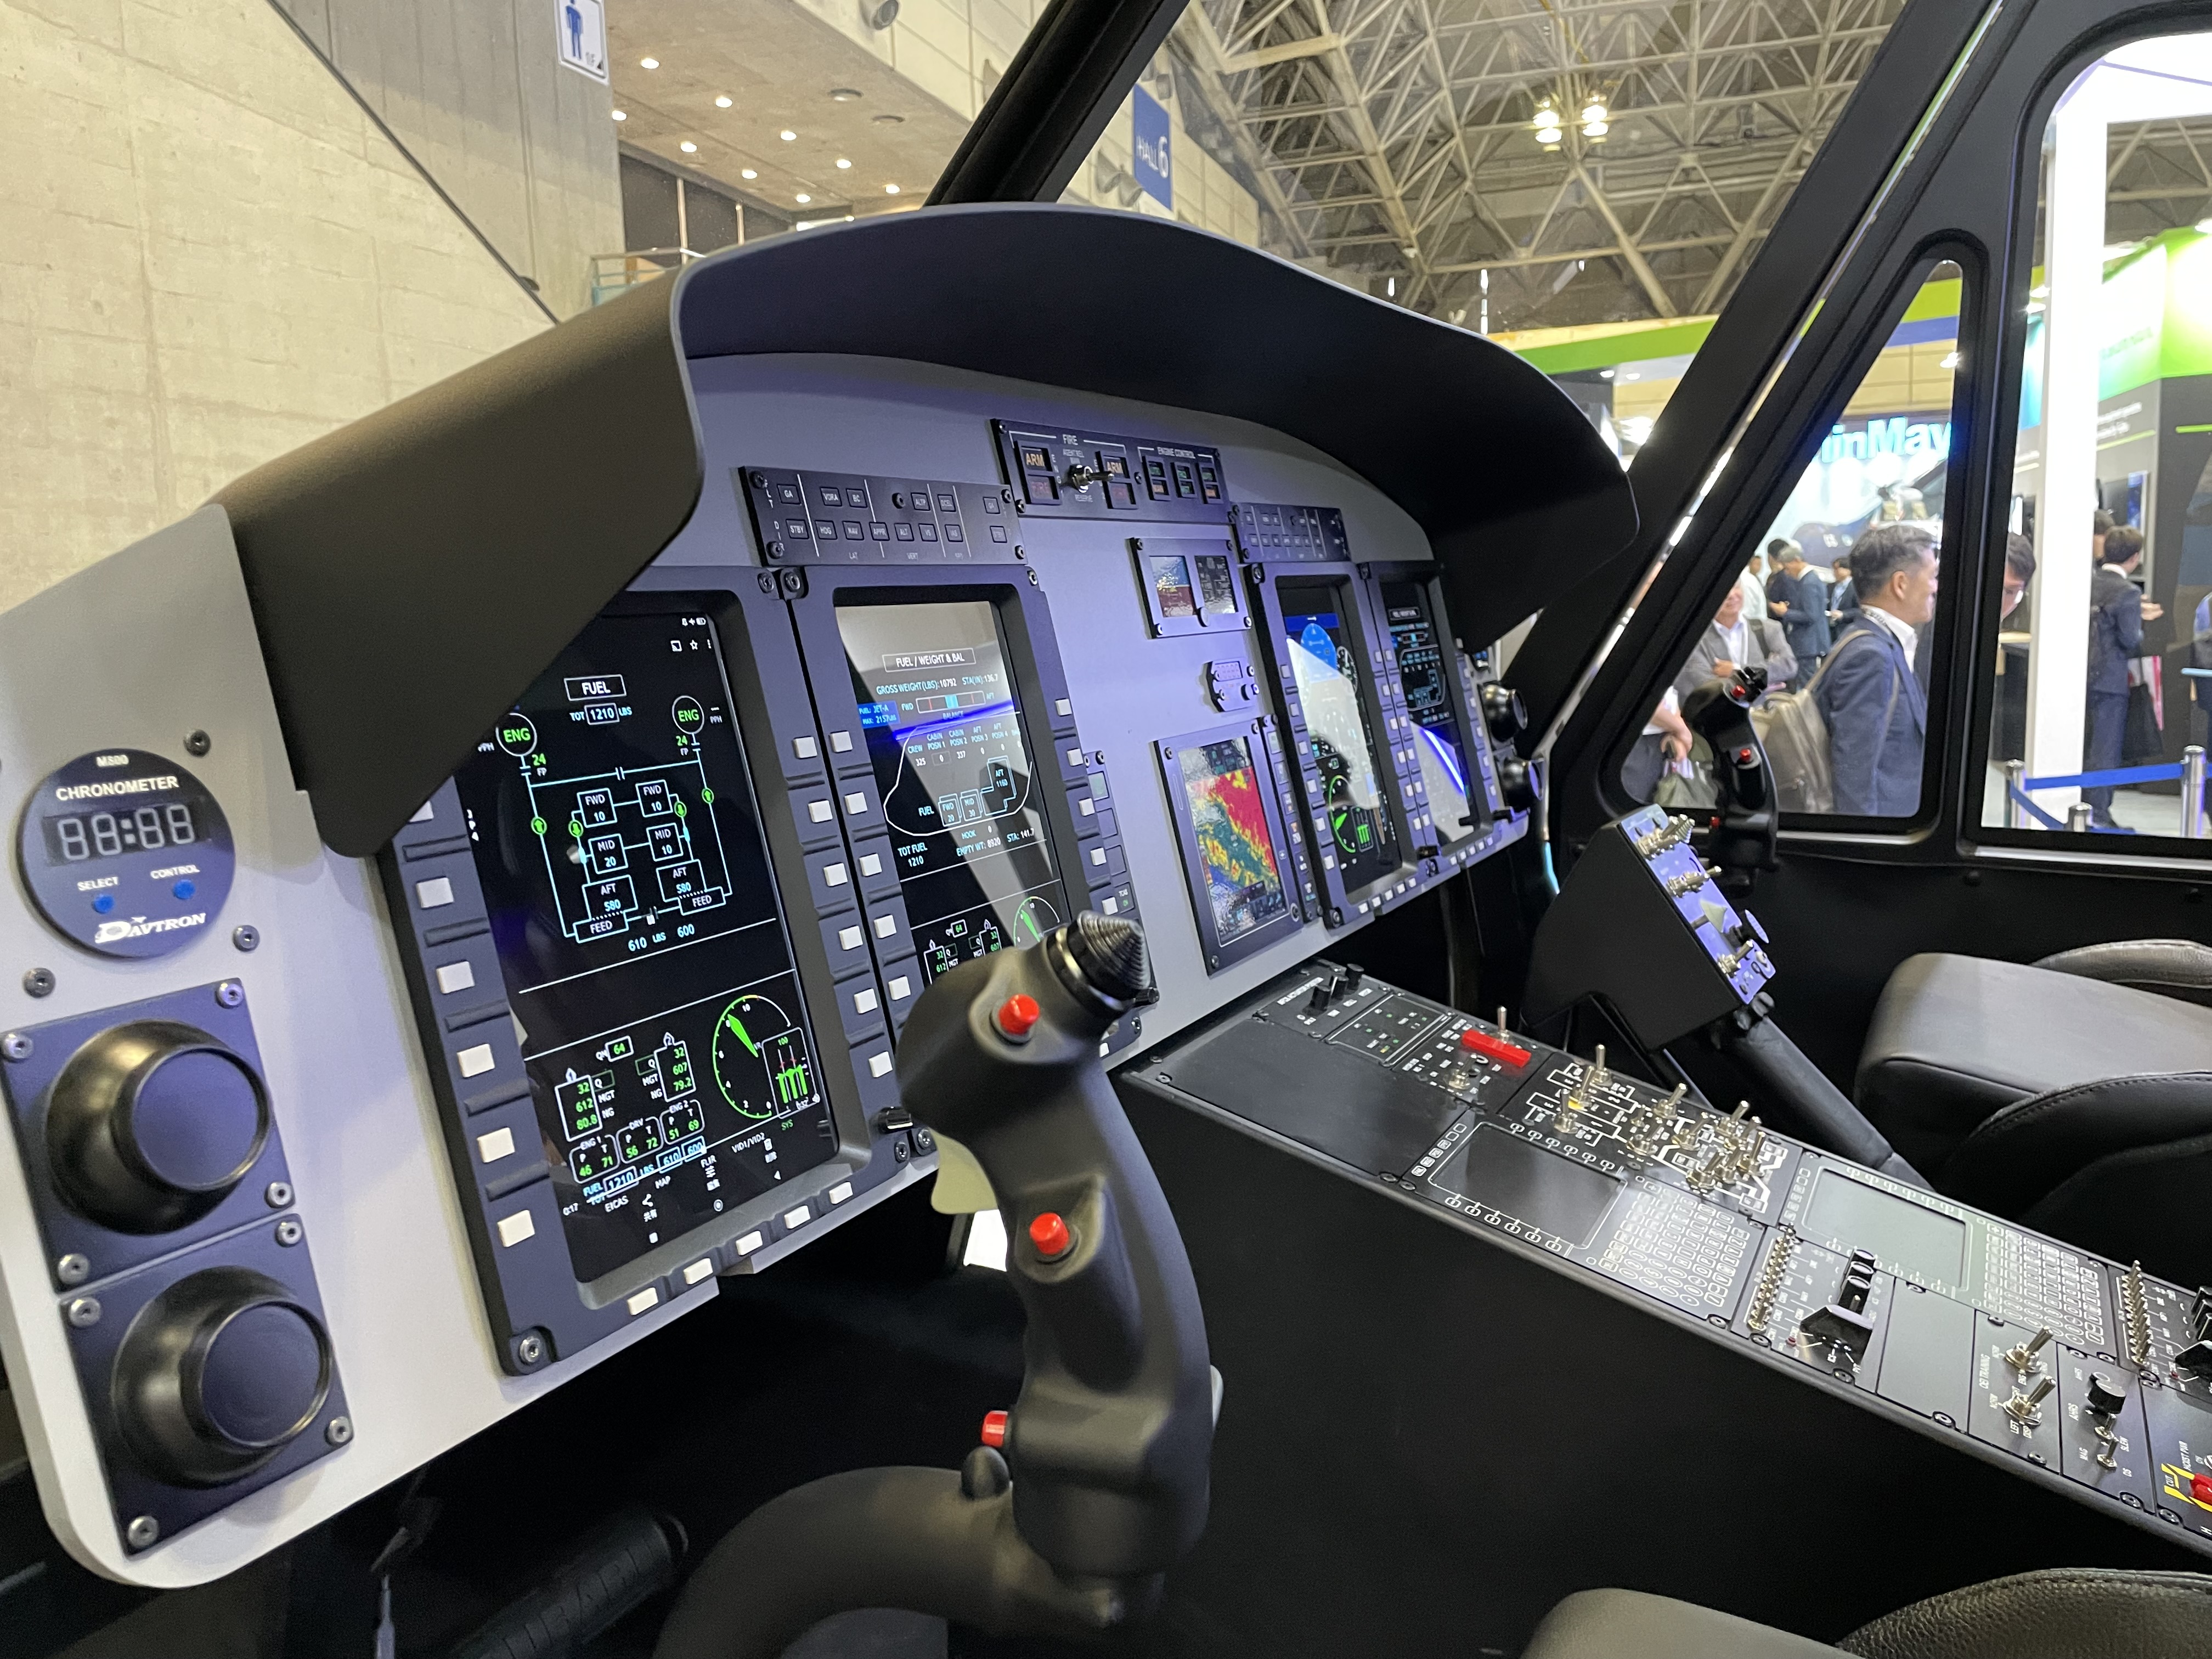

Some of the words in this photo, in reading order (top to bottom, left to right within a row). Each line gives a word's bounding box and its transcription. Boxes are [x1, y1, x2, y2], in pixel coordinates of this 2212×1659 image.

[1158, 136, 1169, 178] 6
[1063, 434, 1078, 445] FIRE
[1025, 453, 1045, 467] ARM
[1107, 461, 1124, 474] ARM
[784, 489, 793, 499] GA
[790, 525, 804, 533] STBY
[895, 657, 913, 668] FUEL
[914, 656, 918, 668] /
[918, 654, 945, 666] WEIGHT
[946, 654, 952, 663] &
[952, 652, 966, 663] BAL
[582, 681, 611, 695] FUEL
[876, 685, 899, 695] GROSS
[873, 704, 889, 713] JET-A
[901, 703, 914, 711] FWD
[569, 711, 585, 722] TOT
[590, 707, 615, 721] 1210
[618, 706, 633, 717] LBS
[678, 709, 700, 723] ENG
[503, 727, 532, 743] ENG
[927, 732, 943, 741] CABIN
[949, 729, 964, 738] CABIN
[675, 735, 688, 747] 24
[907, 745, 923, 754] CREW
[532, 753, 546, 766] 24
[915, 759, 926, 768] 325
[956, 751, 966, 760] 337
[995, 769, 1004, 777] AFT
[55, 776, 179, 801] CHRONOMETER
[643, 785, 662, 797] FWD
[585, 794, 605, 806] FWD
[965, 798, 975, 806] MID
[651, 802, 662, 812] 10
[918, 806, 935, 817] FUEL
[943, 803, 954, 811] FWD
[968, 809, 976, 817] 30
[594, 811, 606, 822] 10
[947, 814, 955, 823] 20
[654, 828, 672, 840] MID
[597, 839, 616, 851] MID
[956, 844, 974, 856] EMPTY
[974, 842, 986, 851] WT:
[987, 837, 1001, 848] 8920
[1007, 833, 1020, 843] STA:
[1020, 828, 1035, 839] 141.7
[661, 845, 673, 855] 10
[898, 845, 911, 857] TOT
[911, 842, 928, 854] FUEL
[604, 856, 617, 867] 20
[908, 855, 924, 867] 1210
[150, 864, 200, 879] CONTROL
[672, 867, 687, 878] AFT
[77, 877, 119, 891] SELECT
[600, 883, 617, 895] AFT
[675, 883, 692, 894] 580
[603, 899, 622, 911] 580
[691, 895, 713, 907] FEED
[590, 921, 613, 934] FEED
[628, 938, 647, 952] 610
[652, 932, 667, 944] LBS
[676, 924, 695, 938] 600
[936, 951, 944, 960] 32
[936, 962, 946, 973] 612
[648, 1058, 656, 1069] Q
[673, 1047, 686, 1059] 32
[673, 1062, 688, 1076] 607
[642, 1073, 659, 1087] NGT
[673, 1077, 692, 1092] 79.2
[577, 1081, 590, 1095] 32
[594, 1078, 603, 1089] Q
[598, 1090, 616, 1104] NGT
[650, 1088, 663, 1100] NG
[575, 1098, 594, 1113] 612
[669, 1102, 683, 1114] ENG
[683, 1100, 689, 1108] 2
[601, 1107, 615, 1119] NG
[668, 1116, 675, 1125] P
[687, 1108, 693, 1117] T
[625, 1134, 632, 1143] P
[645, 1125, 652, 1135] T
[668, 1127, 679, 1140] 51
[687, 1119, 700, 1131] 69
[579, 1153, 586, 1163] P
[601, 1144, 608, 1153] T
[625, 1145, 639, 1159] 56
[646, 1137, 659, 1150] 72
[579, 1164, 593, 1177] 46
[601, 1156, 613, 1168] 71
[583, 1182, 603, 1197] FUEL
[608, 1172, 634, 1190] 1210
[663, 1152, 679, 1166] 610
[687, 1142, 703, 1154] 600
[605, 1195, 629, 1212] EICAS
[655, 1175, 672, 1189] MAP
[731, 1132, 765, 1154] VID1/VID2
[2165, 1474, 2175, 1487] CUT
